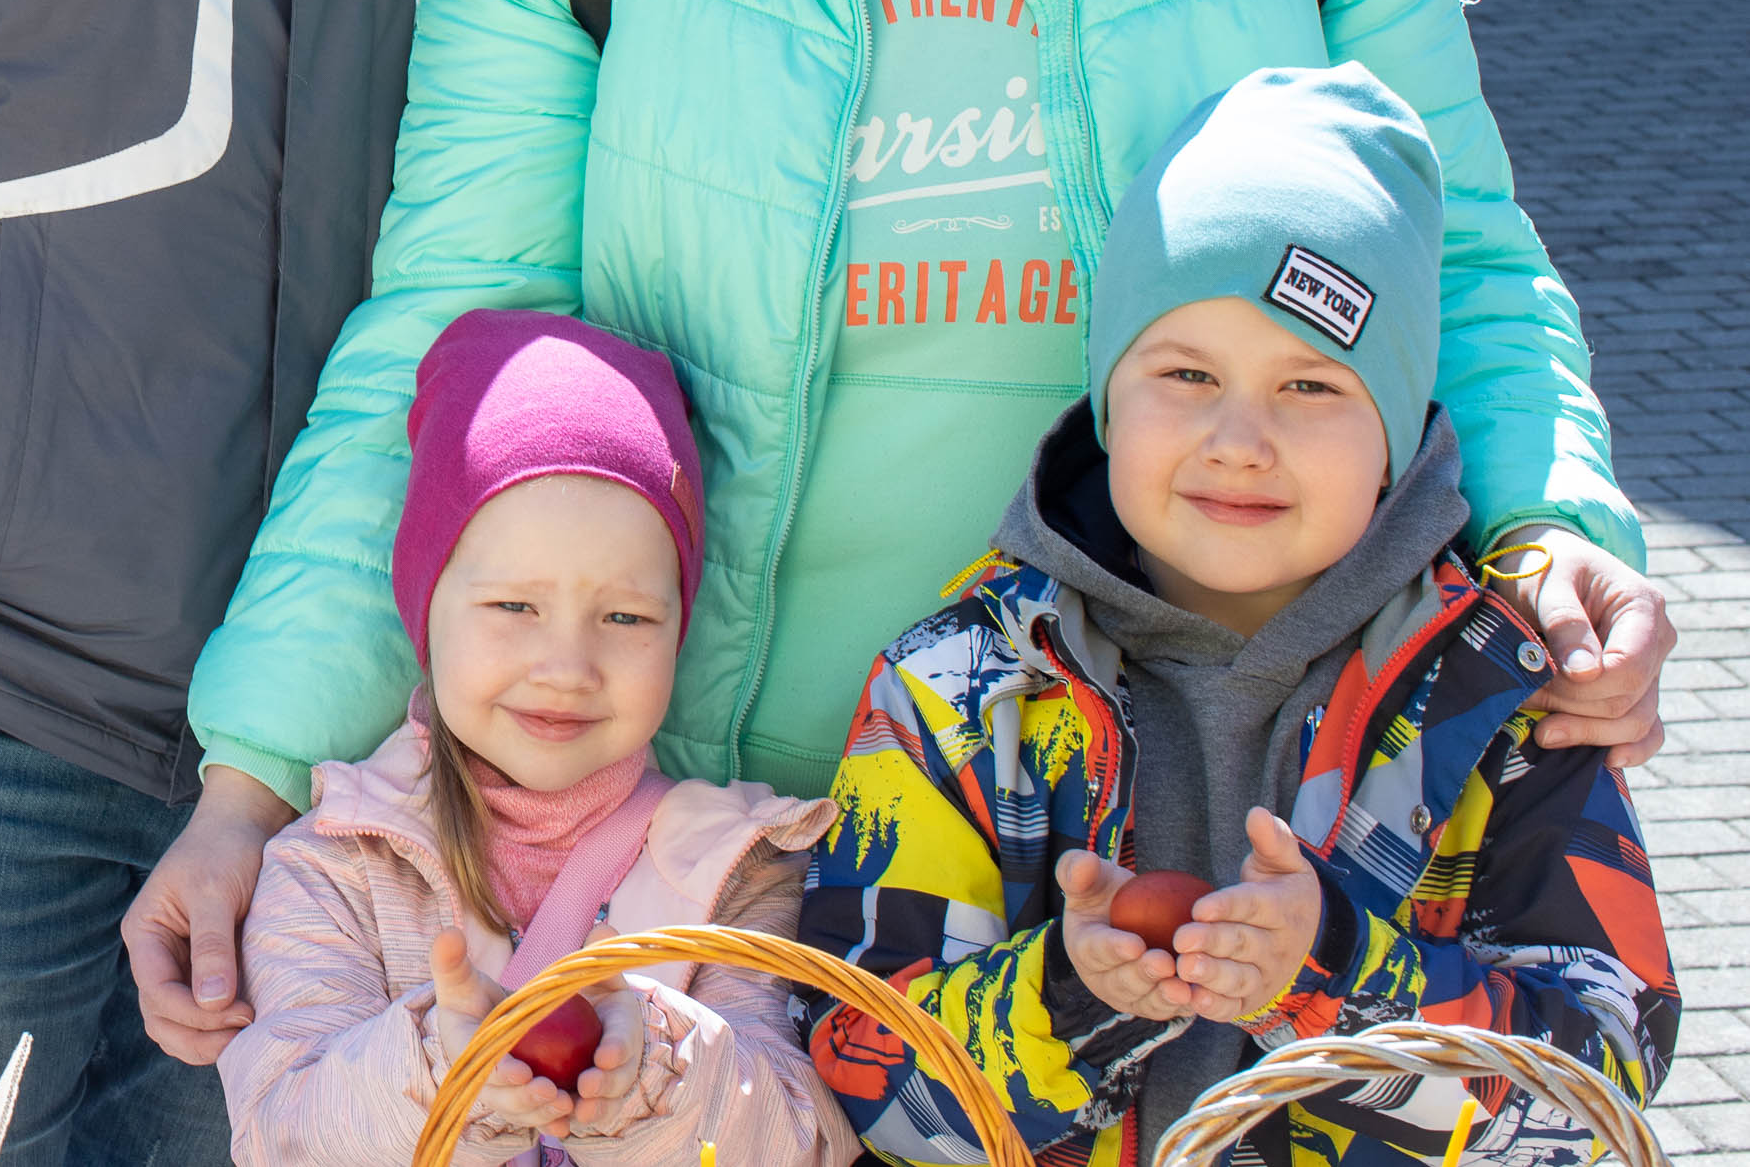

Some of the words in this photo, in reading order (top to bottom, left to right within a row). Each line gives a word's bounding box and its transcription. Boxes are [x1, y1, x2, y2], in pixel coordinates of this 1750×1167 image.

[846, 258, 1079, 327] ERITAGE
[1284, 265, 1325, 299] NEW
[1322, 286, 1361, 325] YORK
